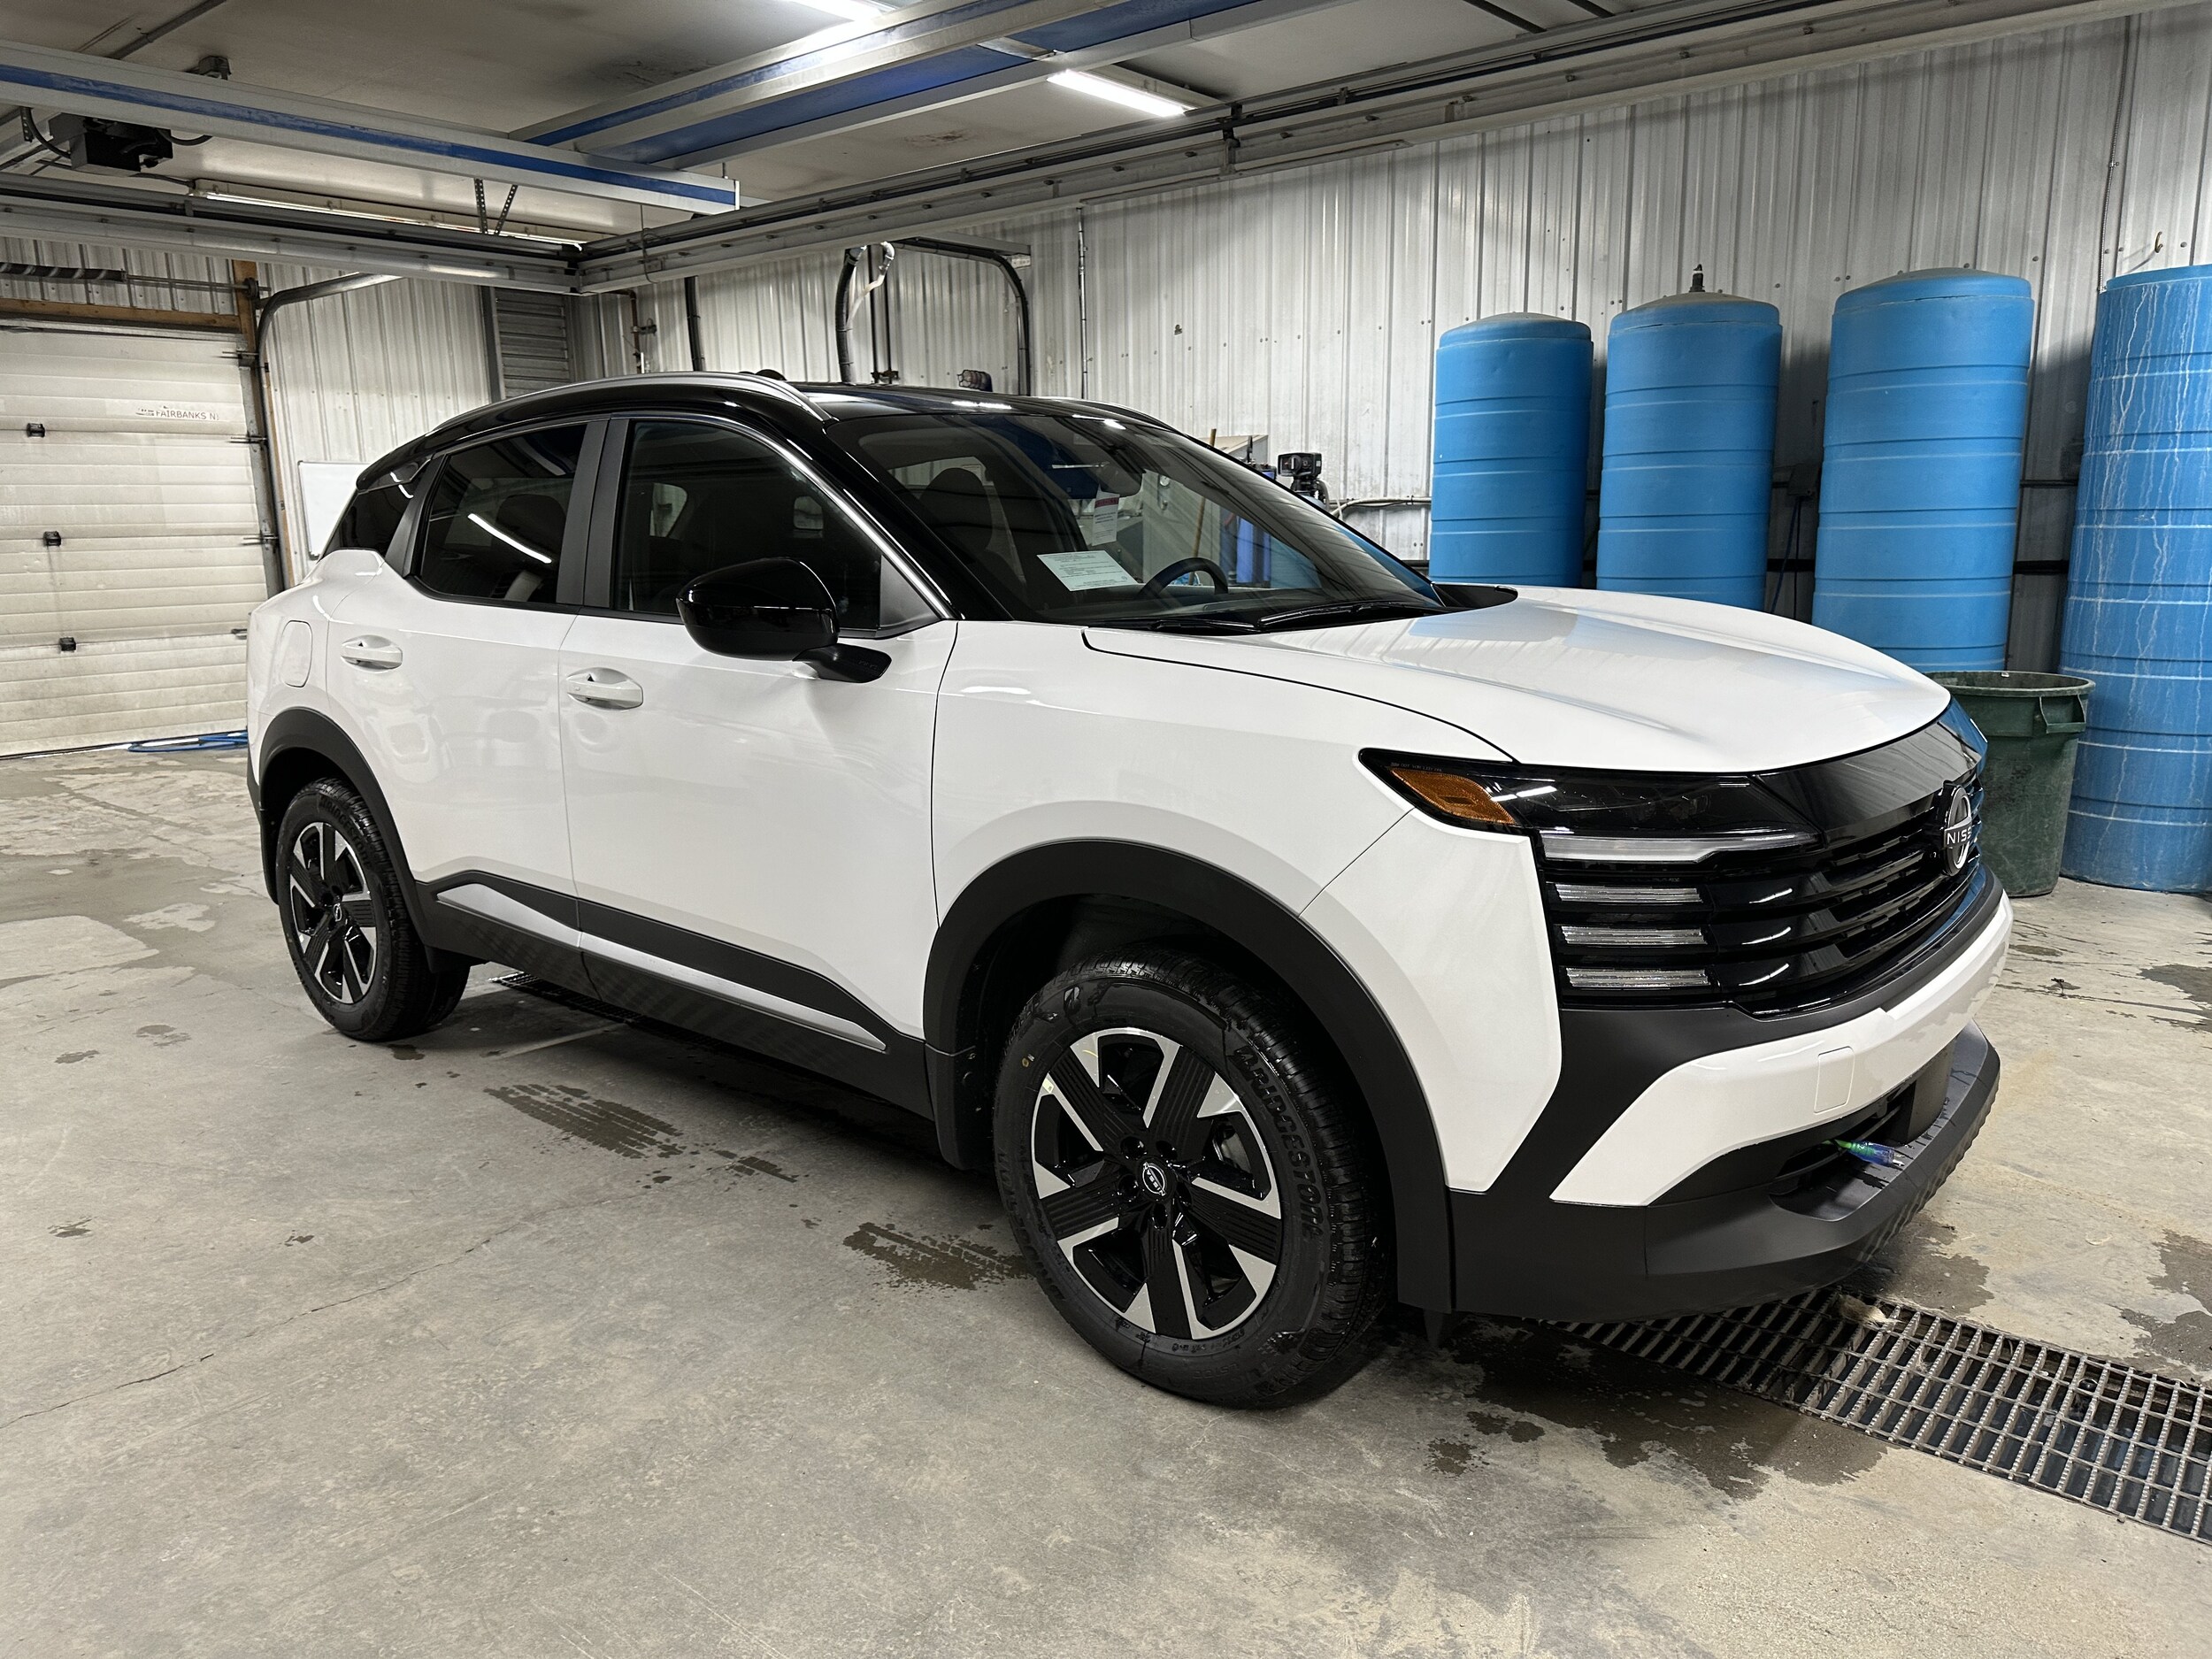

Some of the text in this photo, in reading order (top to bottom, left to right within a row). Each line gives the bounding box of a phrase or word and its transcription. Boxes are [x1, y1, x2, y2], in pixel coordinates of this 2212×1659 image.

[156, 410, 207, 420] FAIRBANKS
[1228, 1045, 1325, 1239] BRIDGESTONE
[1143, 1162, 1166, 1196] NISSAN
